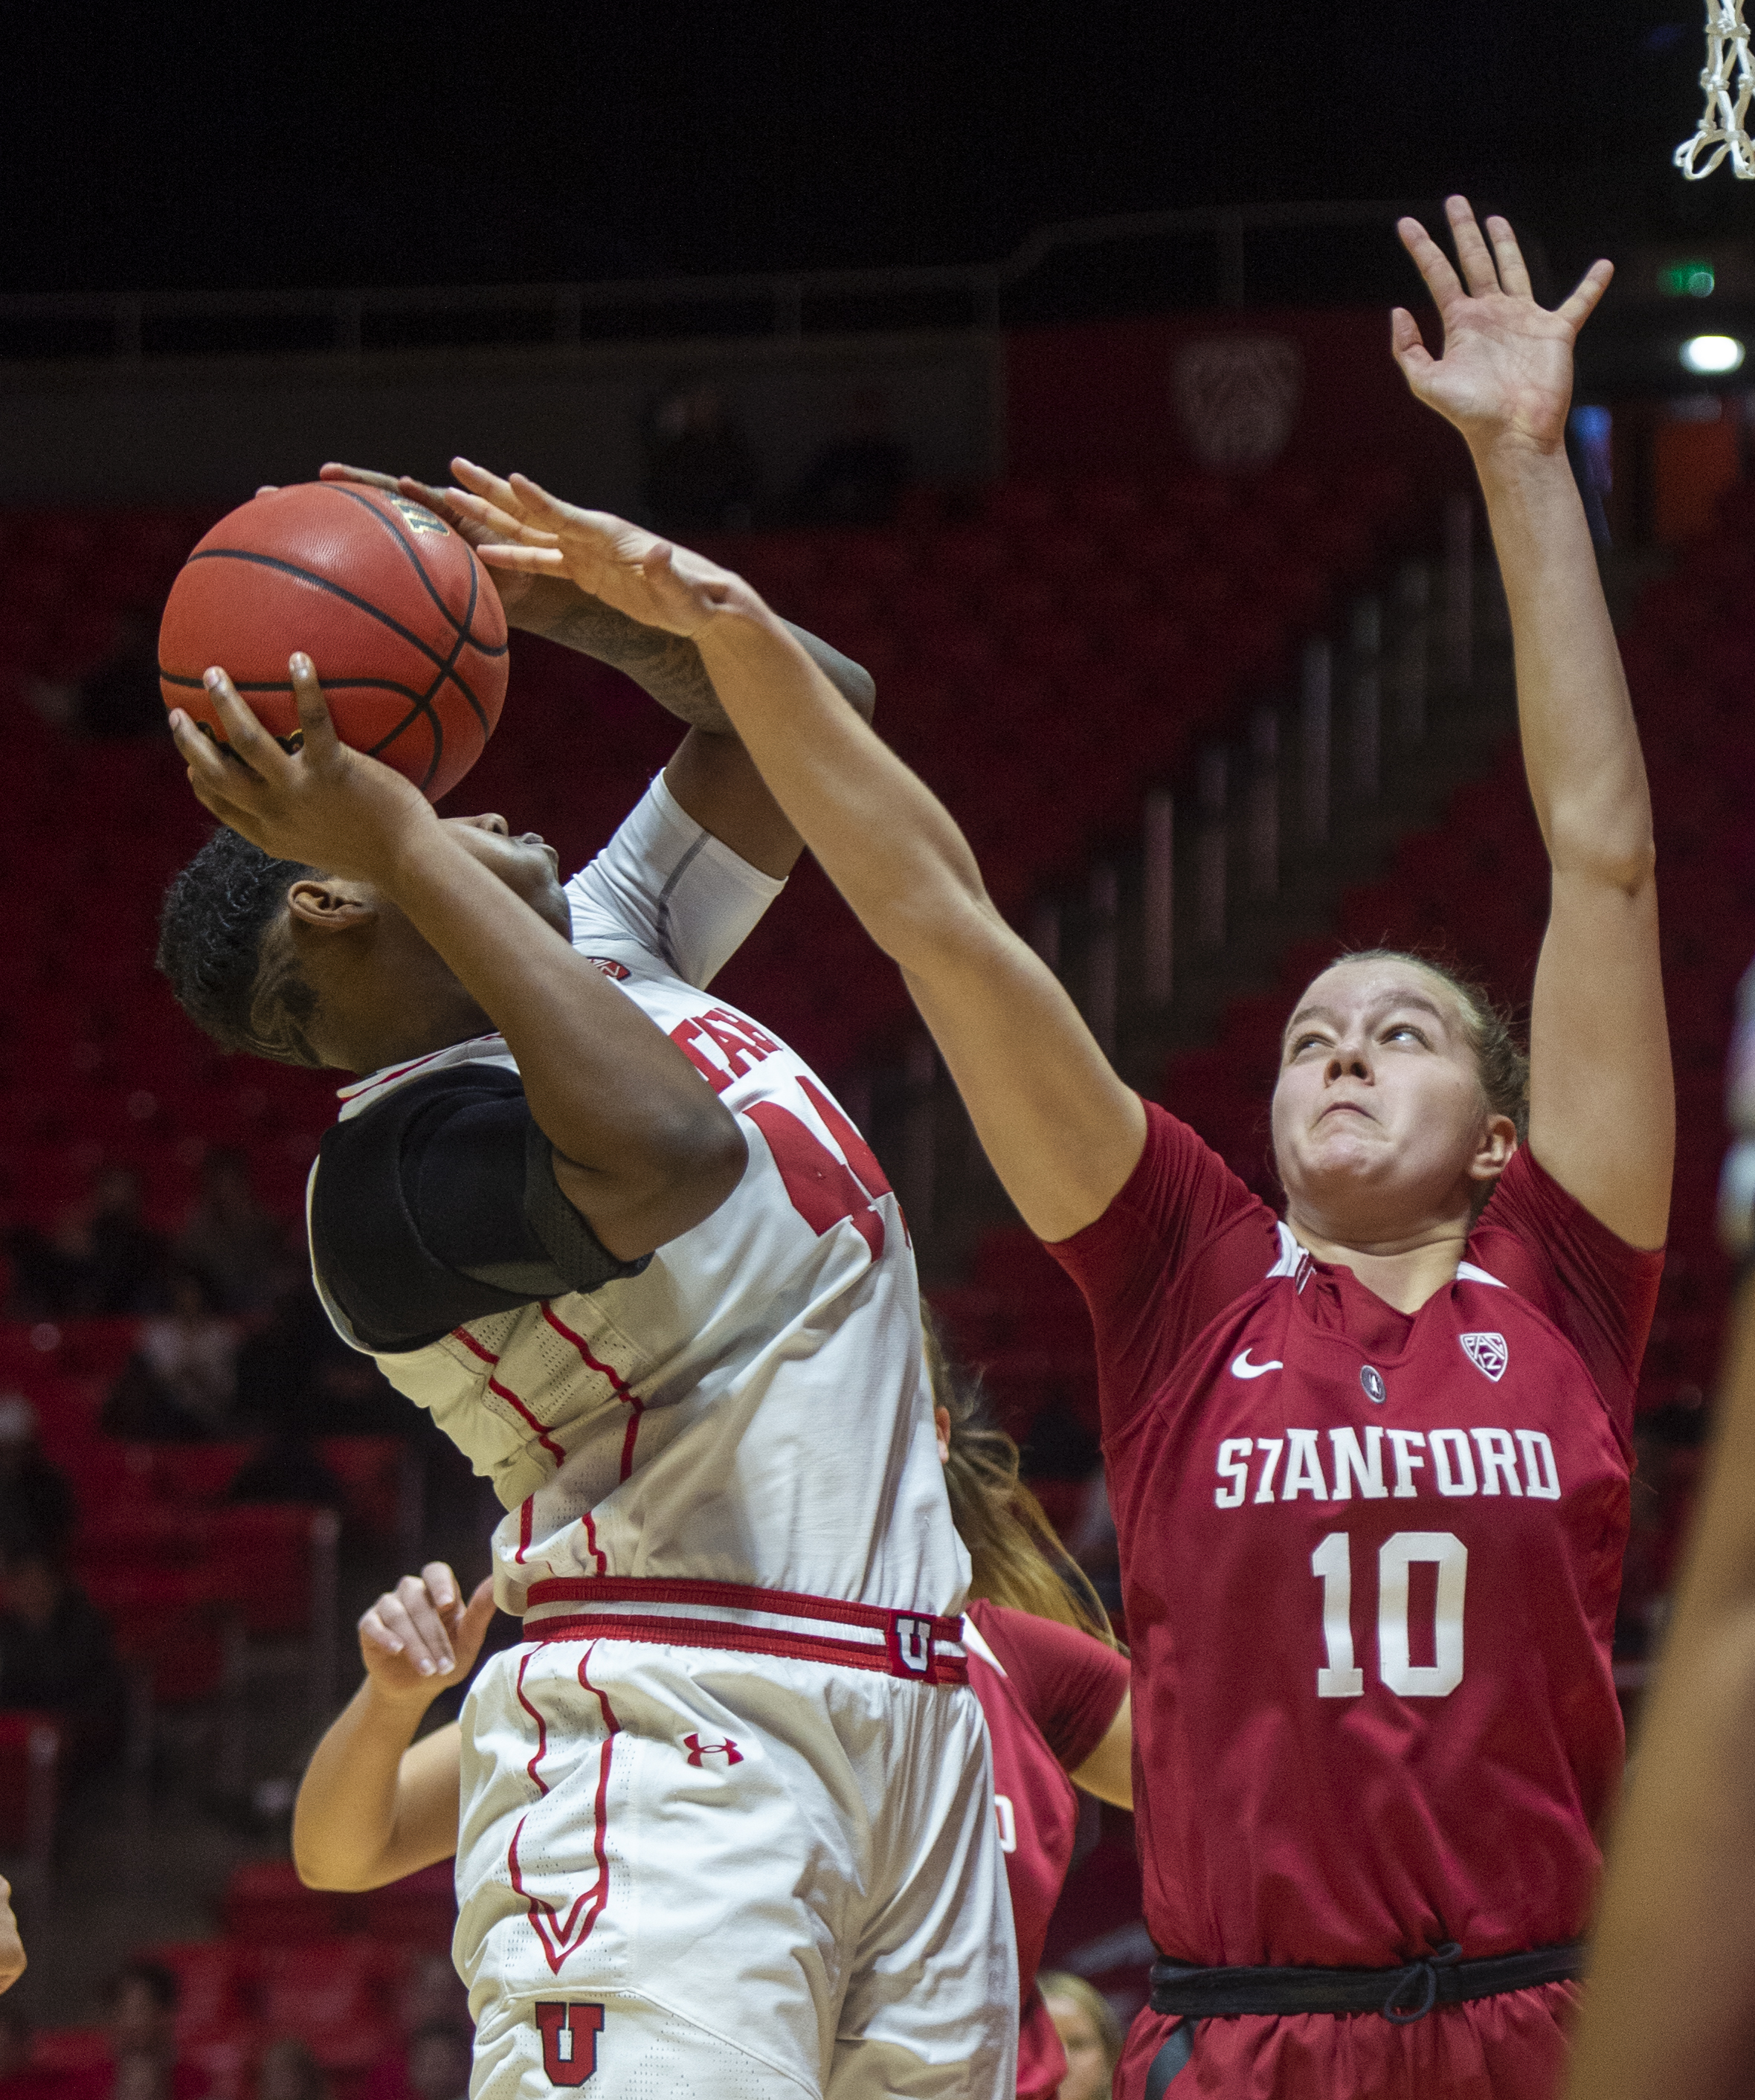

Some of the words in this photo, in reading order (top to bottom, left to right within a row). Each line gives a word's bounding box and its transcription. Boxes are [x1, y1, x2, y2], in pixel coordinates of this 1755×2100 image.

[669, 1007, 784, 1095] TAH
[1477, 1352, 1502, 1370] 12
[895, 1615, 931, 1673] U
[1311, 1531, 1469, 1698] 10
[535, 2001, 605, 2087] U
